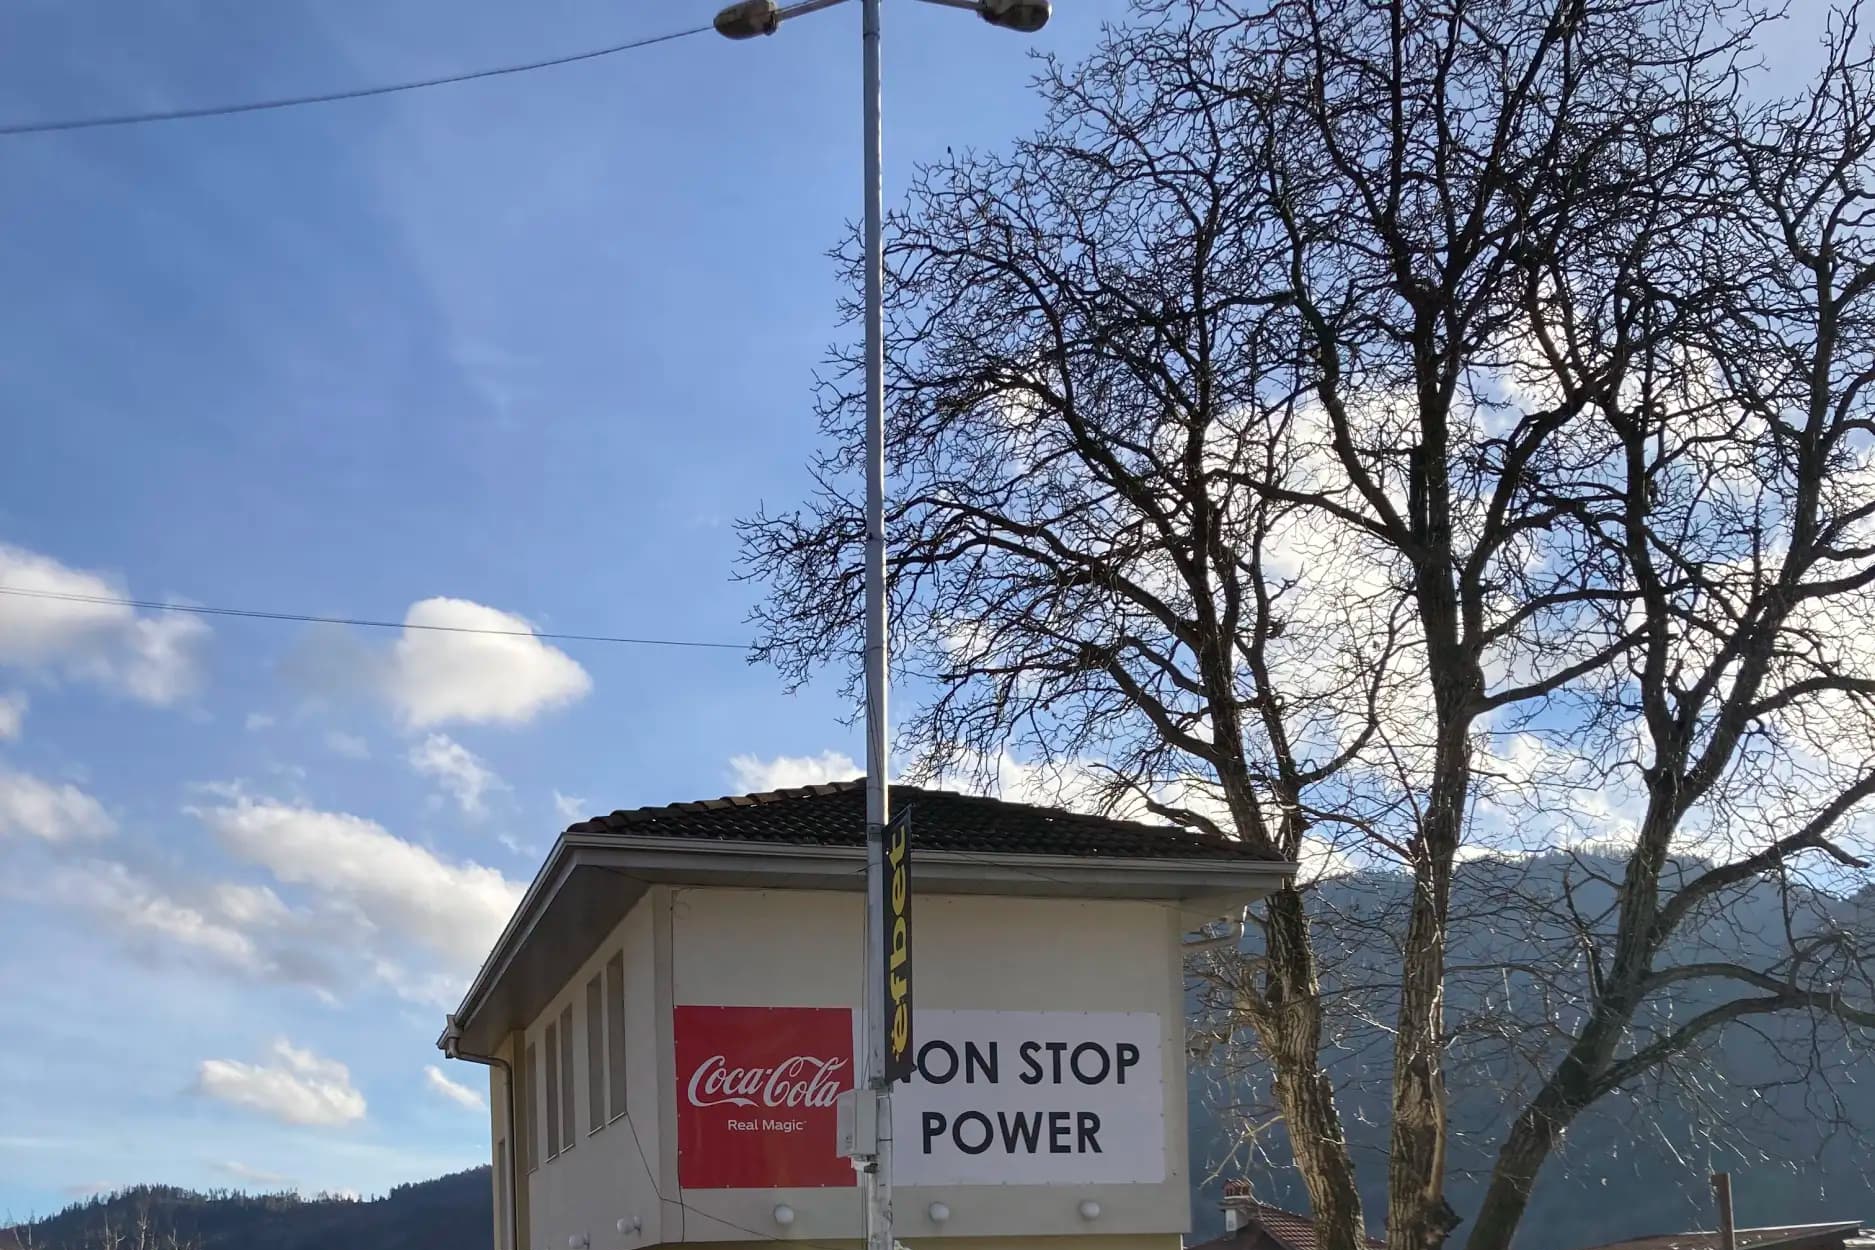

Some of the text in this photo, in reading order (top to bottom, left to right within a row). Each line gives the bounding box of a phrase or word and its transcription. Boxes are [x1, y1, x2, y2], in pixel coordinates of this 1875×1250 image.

[889, 824, 908, 1054] efbet
[901, 1040, 1140, 1085] ON STOP
[728, 1119, 803, 1132] Real Magic
[921, 1110, 1103, 1154] POWER
